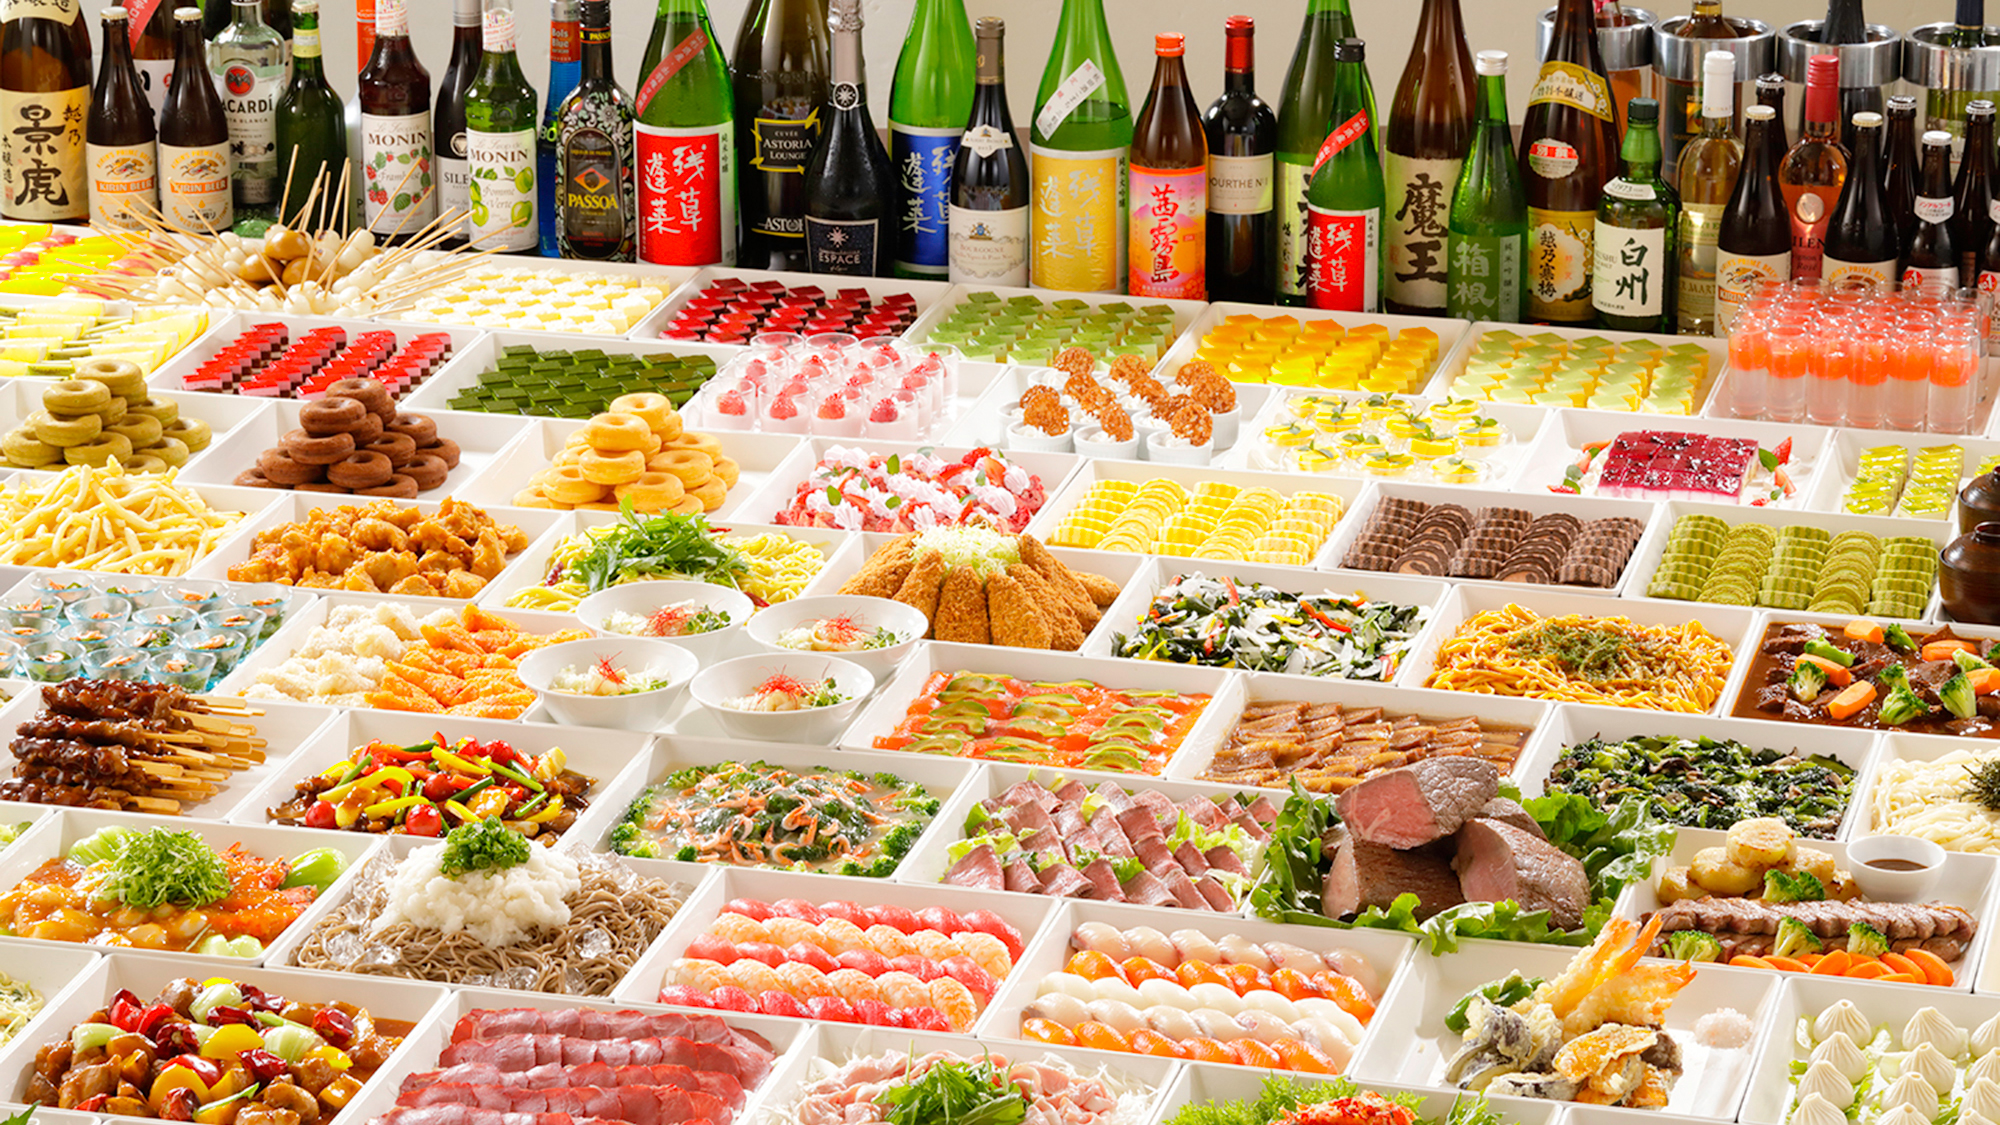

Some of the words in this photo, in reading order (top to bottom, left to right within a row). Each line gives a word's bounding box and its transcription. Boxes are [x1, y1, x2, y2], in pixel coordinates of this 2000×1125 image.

[590, 31, 611, 41] PASSO
[62, 104, 82, 147] 越乃
[368, 131, 427, 146] MONIN
[763, 138, 813, 150] ASTORIA
[12, 104, 70, 207] 景虎
[470, 148, 528, 163] MONIN
[769, 151, 807, 160] LOUNGE
[99, 183, 128, 192] KIRIN
[130, 181, 153, 191] BEER
[175, 184, 203, 193] KIRIN
[205, 181, 227, 191] BEER
[1395, 172, 1449, 284] 魔王
[818, 253, 861, 265] ESPACE
[1538, 230, 1557, 298] 越乃寒梅
[1614, 236, 1649, 306] 白州
